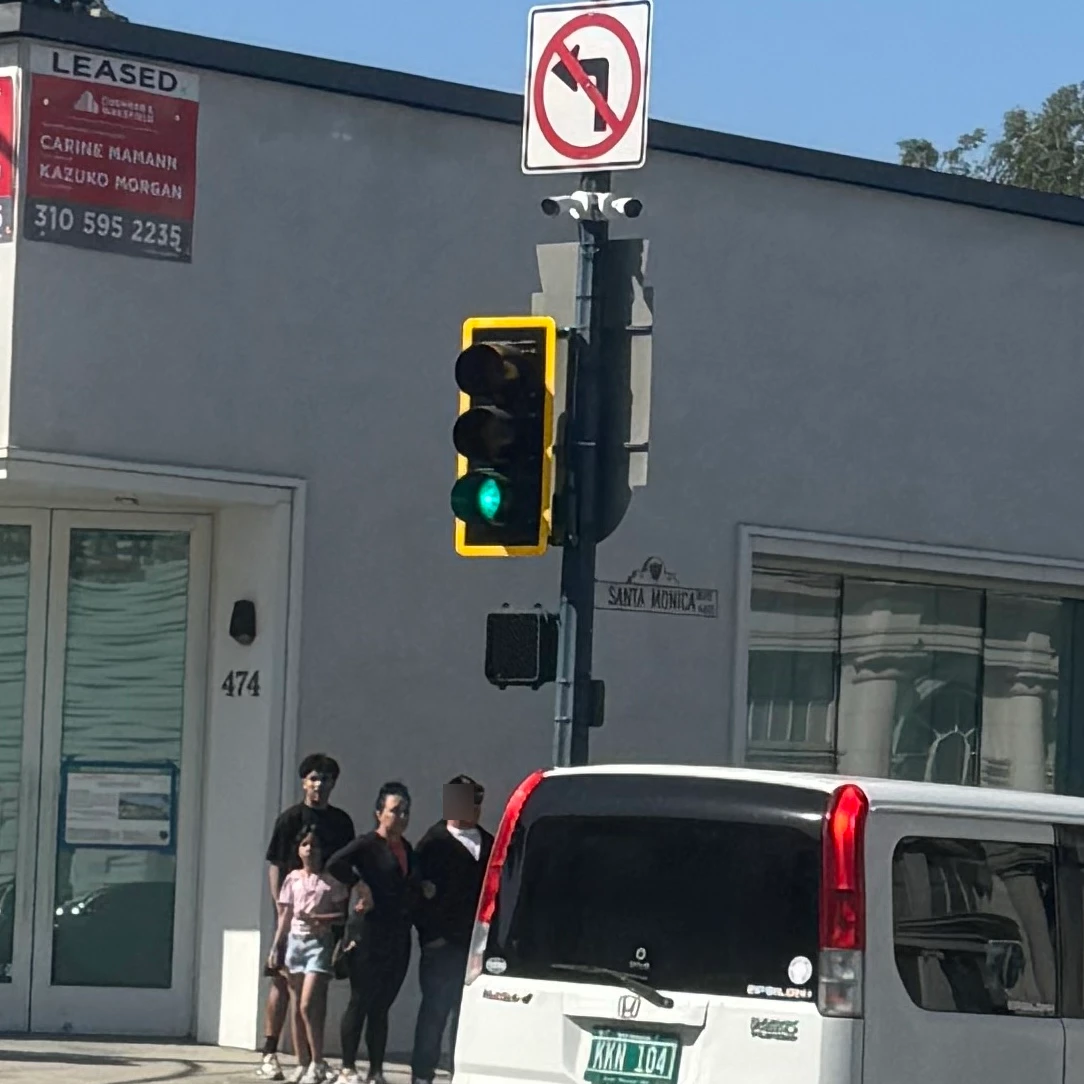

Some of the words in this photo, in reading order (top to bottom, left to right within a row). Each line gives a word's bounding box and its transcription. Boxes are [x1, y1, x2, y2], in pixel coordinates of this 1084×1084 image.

[52, 51, 178, 92] LEASED
[40, 134, 103, 158] CARINE
[108, 145, 178, 171] MAMANN
[39, 164, 109, 188] KAZUKO
[115, 175, 182, 199] MORGAN
[34, 204, 74, 231] 310
[83, 210, 123, 238] 595
[131, 219, 182, 250] 2235
[608, 585, 645, 608] SANTA
[650, 589, 696, 612] MONICA
[221, 671, 261, 697] 474
[592, 1041, 627, 1072] KKN
[634, 1045, 668, 1076] 104
